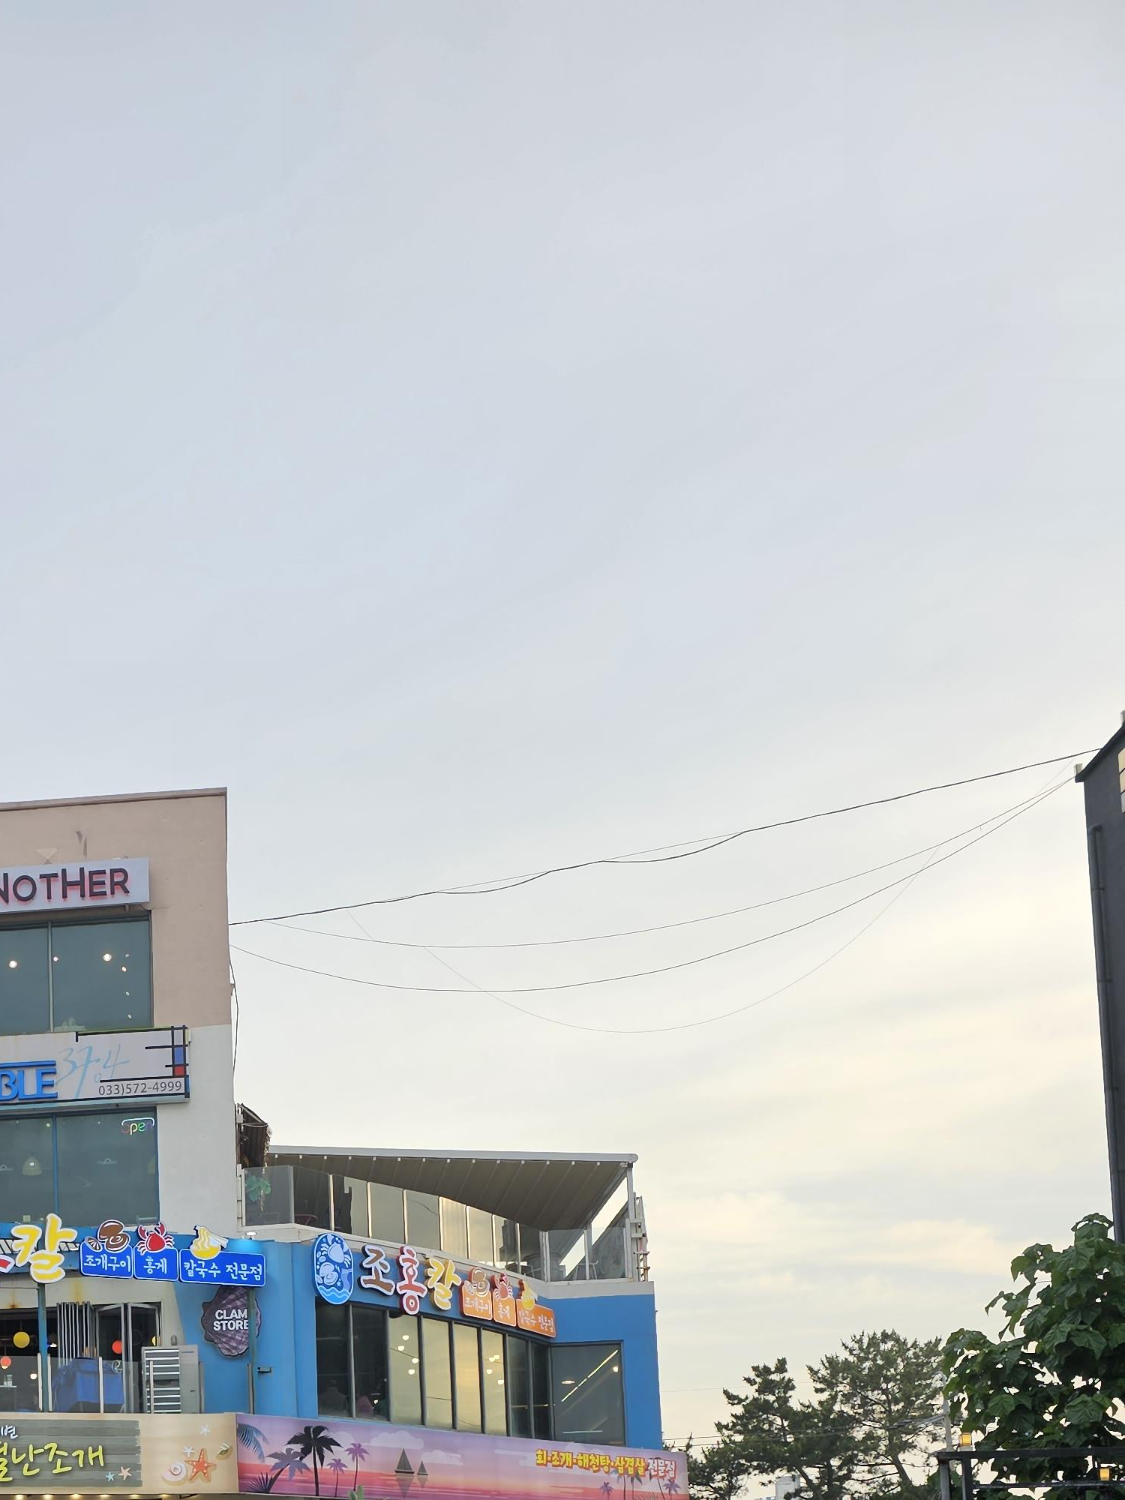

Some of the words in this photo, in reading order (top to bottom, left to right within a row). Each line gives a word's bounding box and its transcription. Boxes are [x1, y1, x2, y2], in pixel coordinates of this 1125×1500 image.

[98, 1081, 182, 1096] 033)572-4999
[83, 1253, 131, 1272] 조개구이
[143, 1256, 168, 1274] 홍게
[183, 1259, 221, 1278] 칼국수
[225, 1262, 263, 1280] 전문점
[360, 1244, 462, 1316] 조홍칼
[215, 1309, 248, 1320] CLAM
